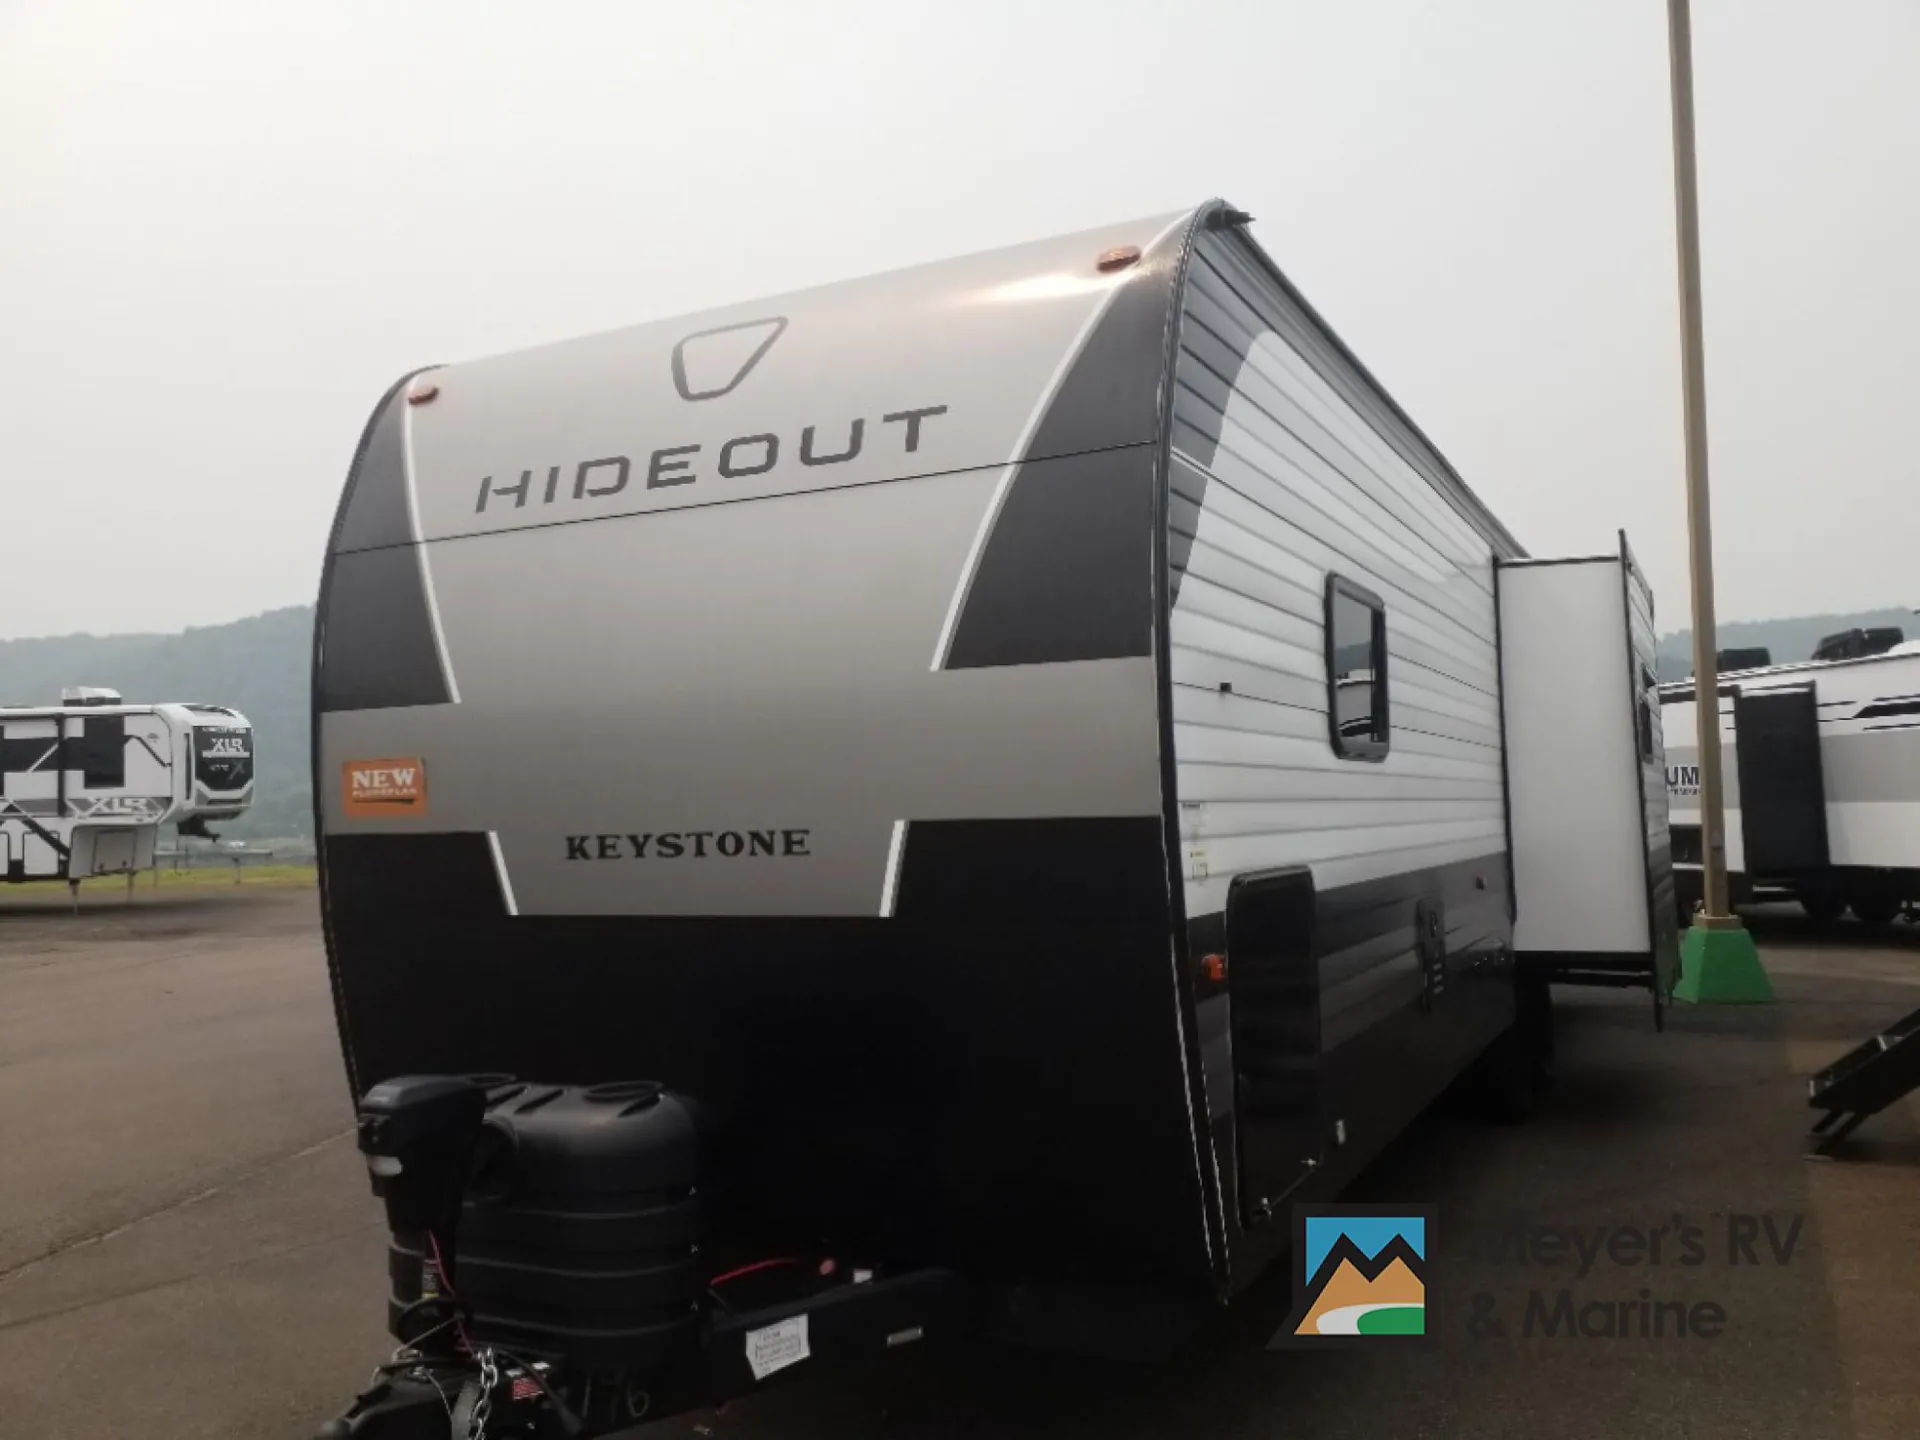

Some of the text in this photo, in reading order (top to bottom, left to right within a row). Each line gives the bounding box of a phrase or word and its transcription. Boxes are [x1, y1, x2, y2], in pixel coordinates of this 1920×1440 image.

[476, 405, 948, 513] HIDEOUT
[211, 738, 244, 753] XLR
[351, 768, 417, 788] NEW
[565, 829, 812, 860] KEYSTONE
